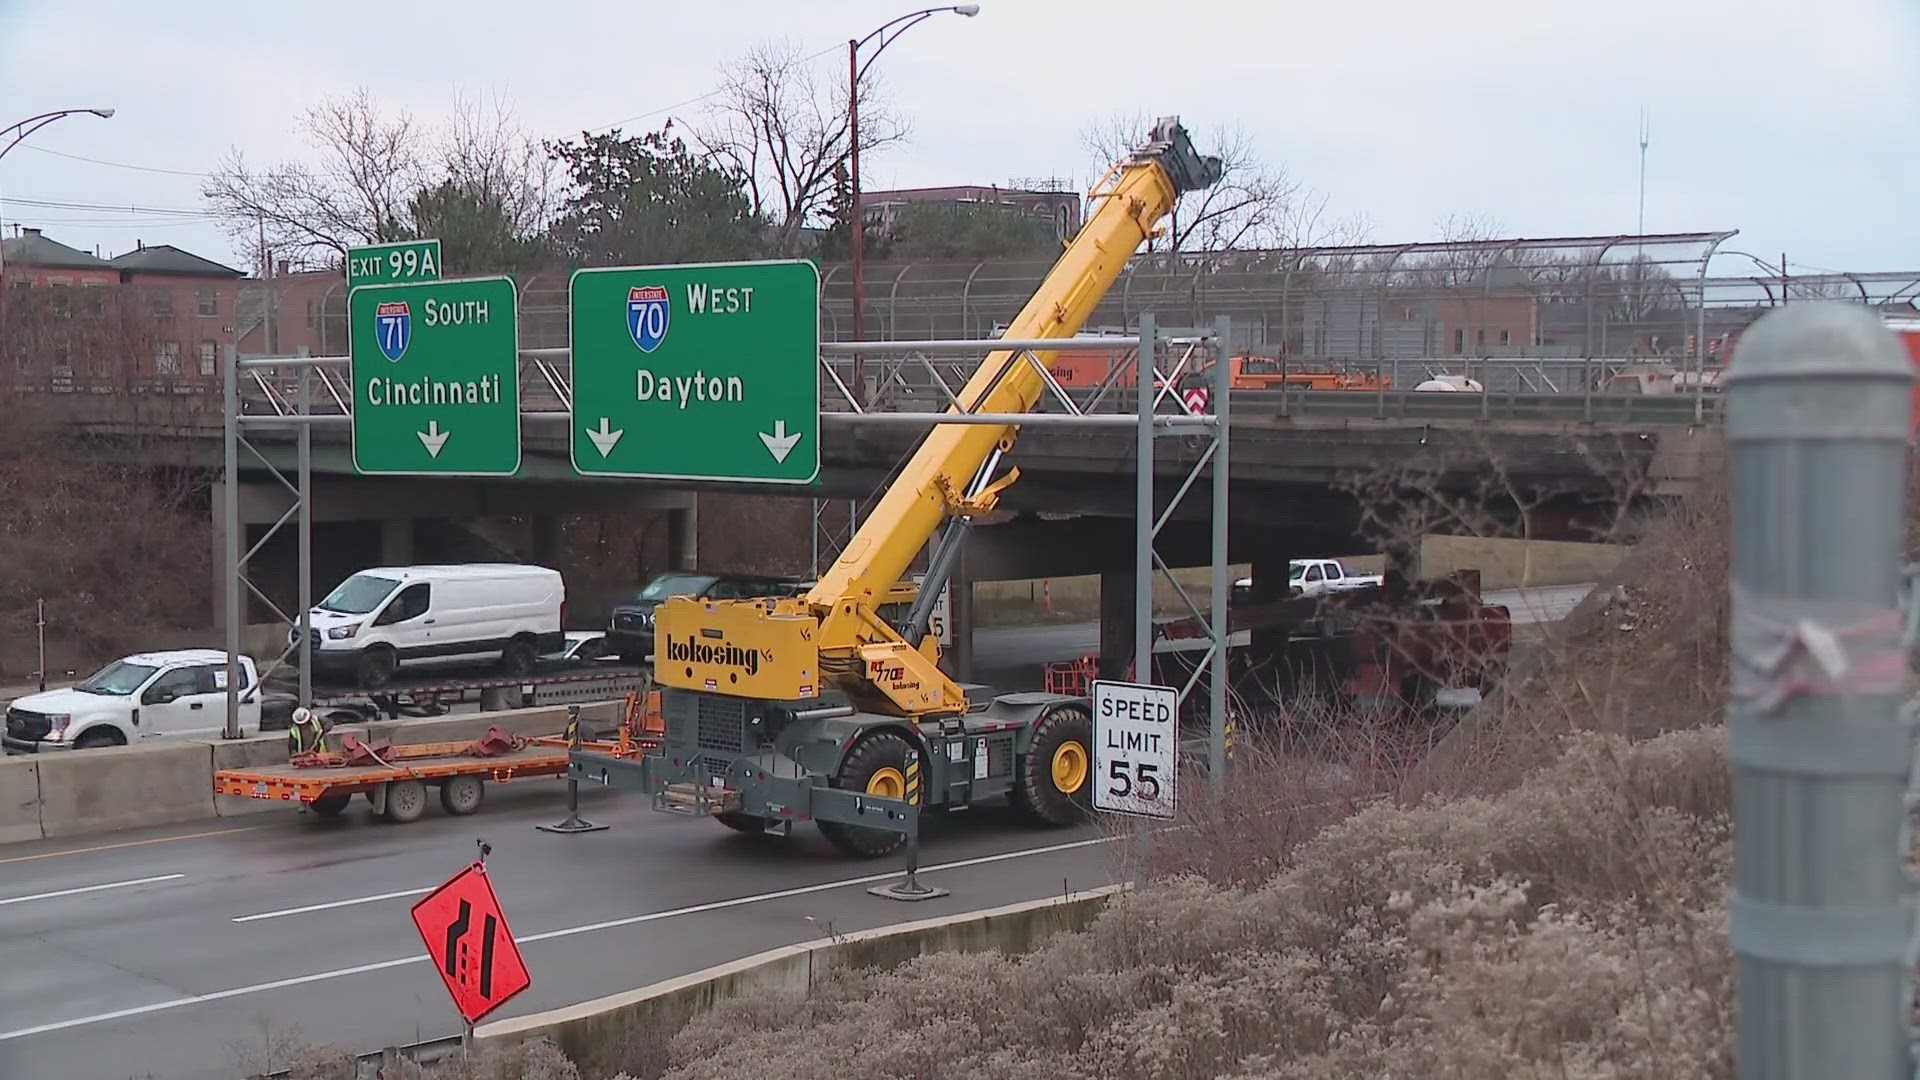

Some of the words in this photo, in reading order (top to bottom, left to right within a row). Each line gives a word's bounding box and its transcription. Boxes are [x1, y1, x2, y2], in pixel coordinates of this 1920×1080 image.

[351, 257, 382, 277] EXIT
[389, 248, 436, 278] 99A
[380, 305, 405, 315] INTERSTATE
[632, 290, 663, 300] INTERSTATE
[686, 283, 753, 314] WEST
[425, 298, 489, 326] SOUTH
[631, 302, 664, 339] 70
[382, 317, 403, 350] 71
[368, 373, 499, 406] Cincinnati
[637, 369, 743, 409] Dayton
[667, 633, 758, 676] kokosing
[870, 660, 884, 672] RT
[1101, 698, 1170, 723] SPEED
[1107, 729, 1161, 753] LIMIT
[1109, 760, 1160, 801] 55
